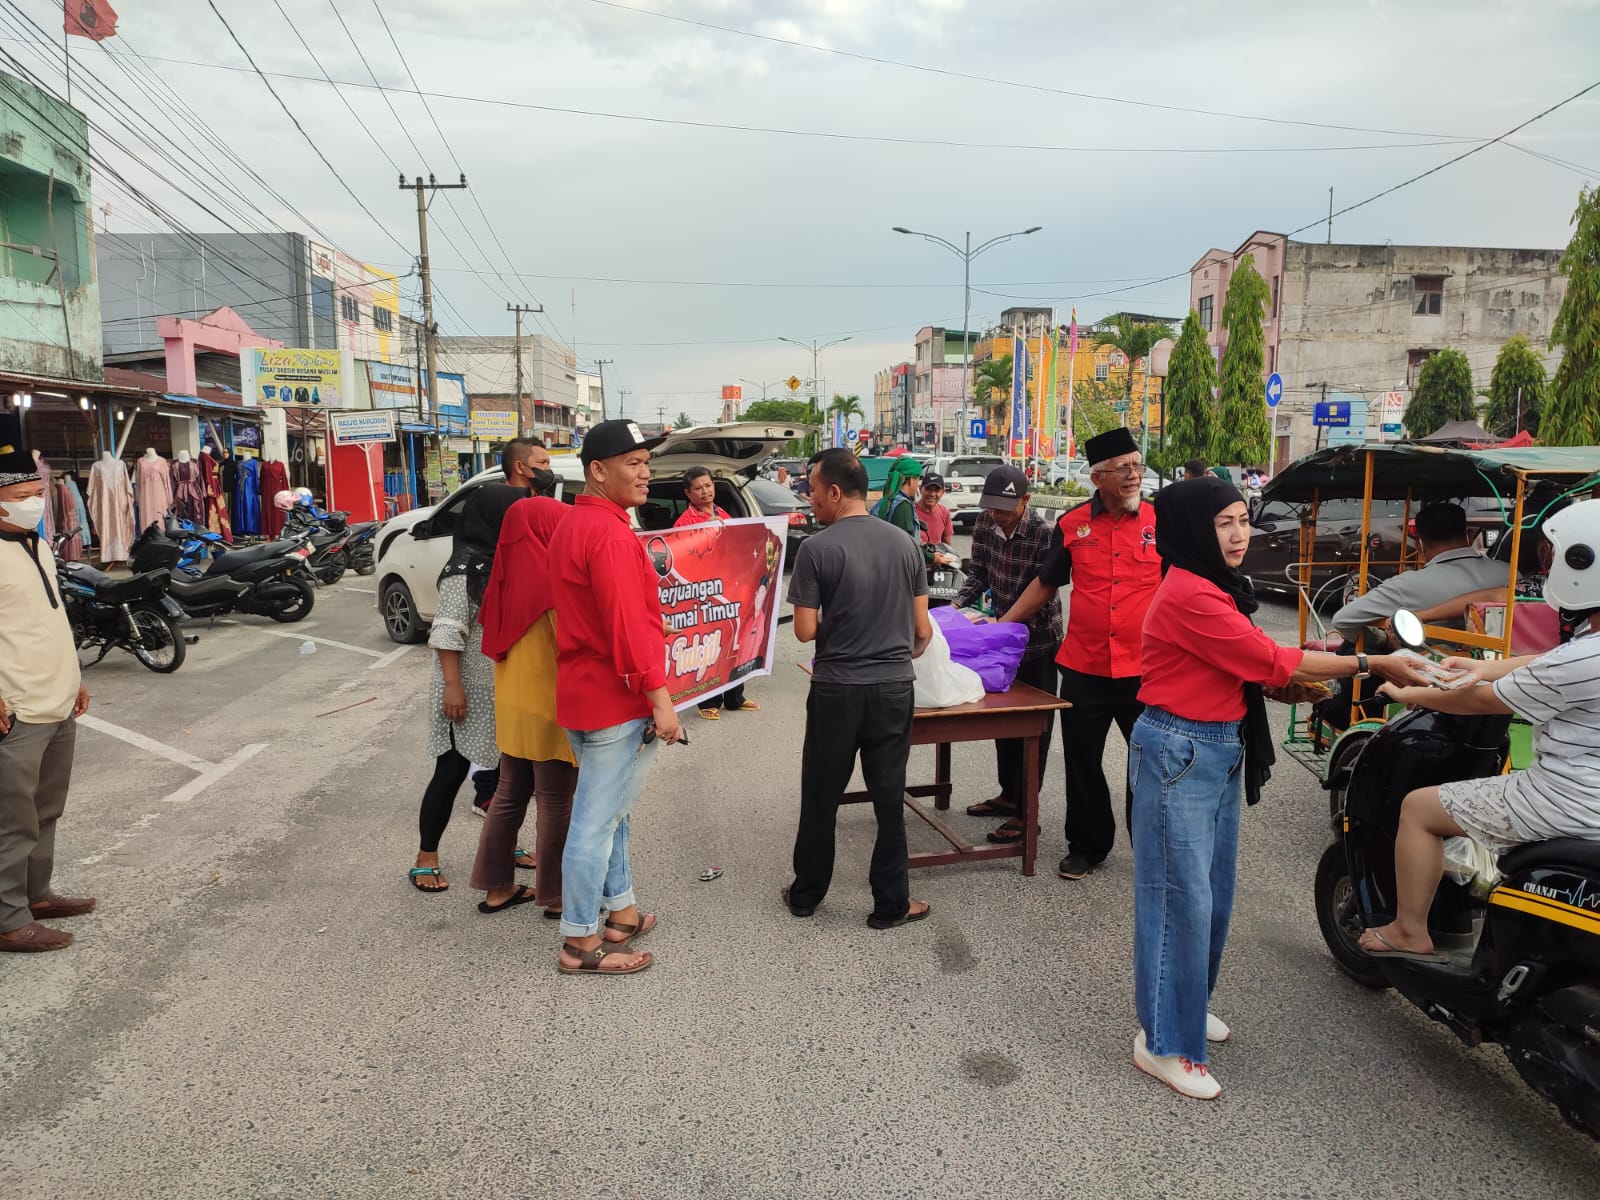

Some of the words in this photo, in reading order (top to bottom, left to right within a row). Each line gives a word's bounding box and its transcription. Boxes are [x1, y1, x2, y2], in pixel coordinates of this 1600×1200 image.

[260, 351, 291, 366] Liza
[700, 601, 741, 624] Timur
[1523, 882, 1558, 899] CHANJI
